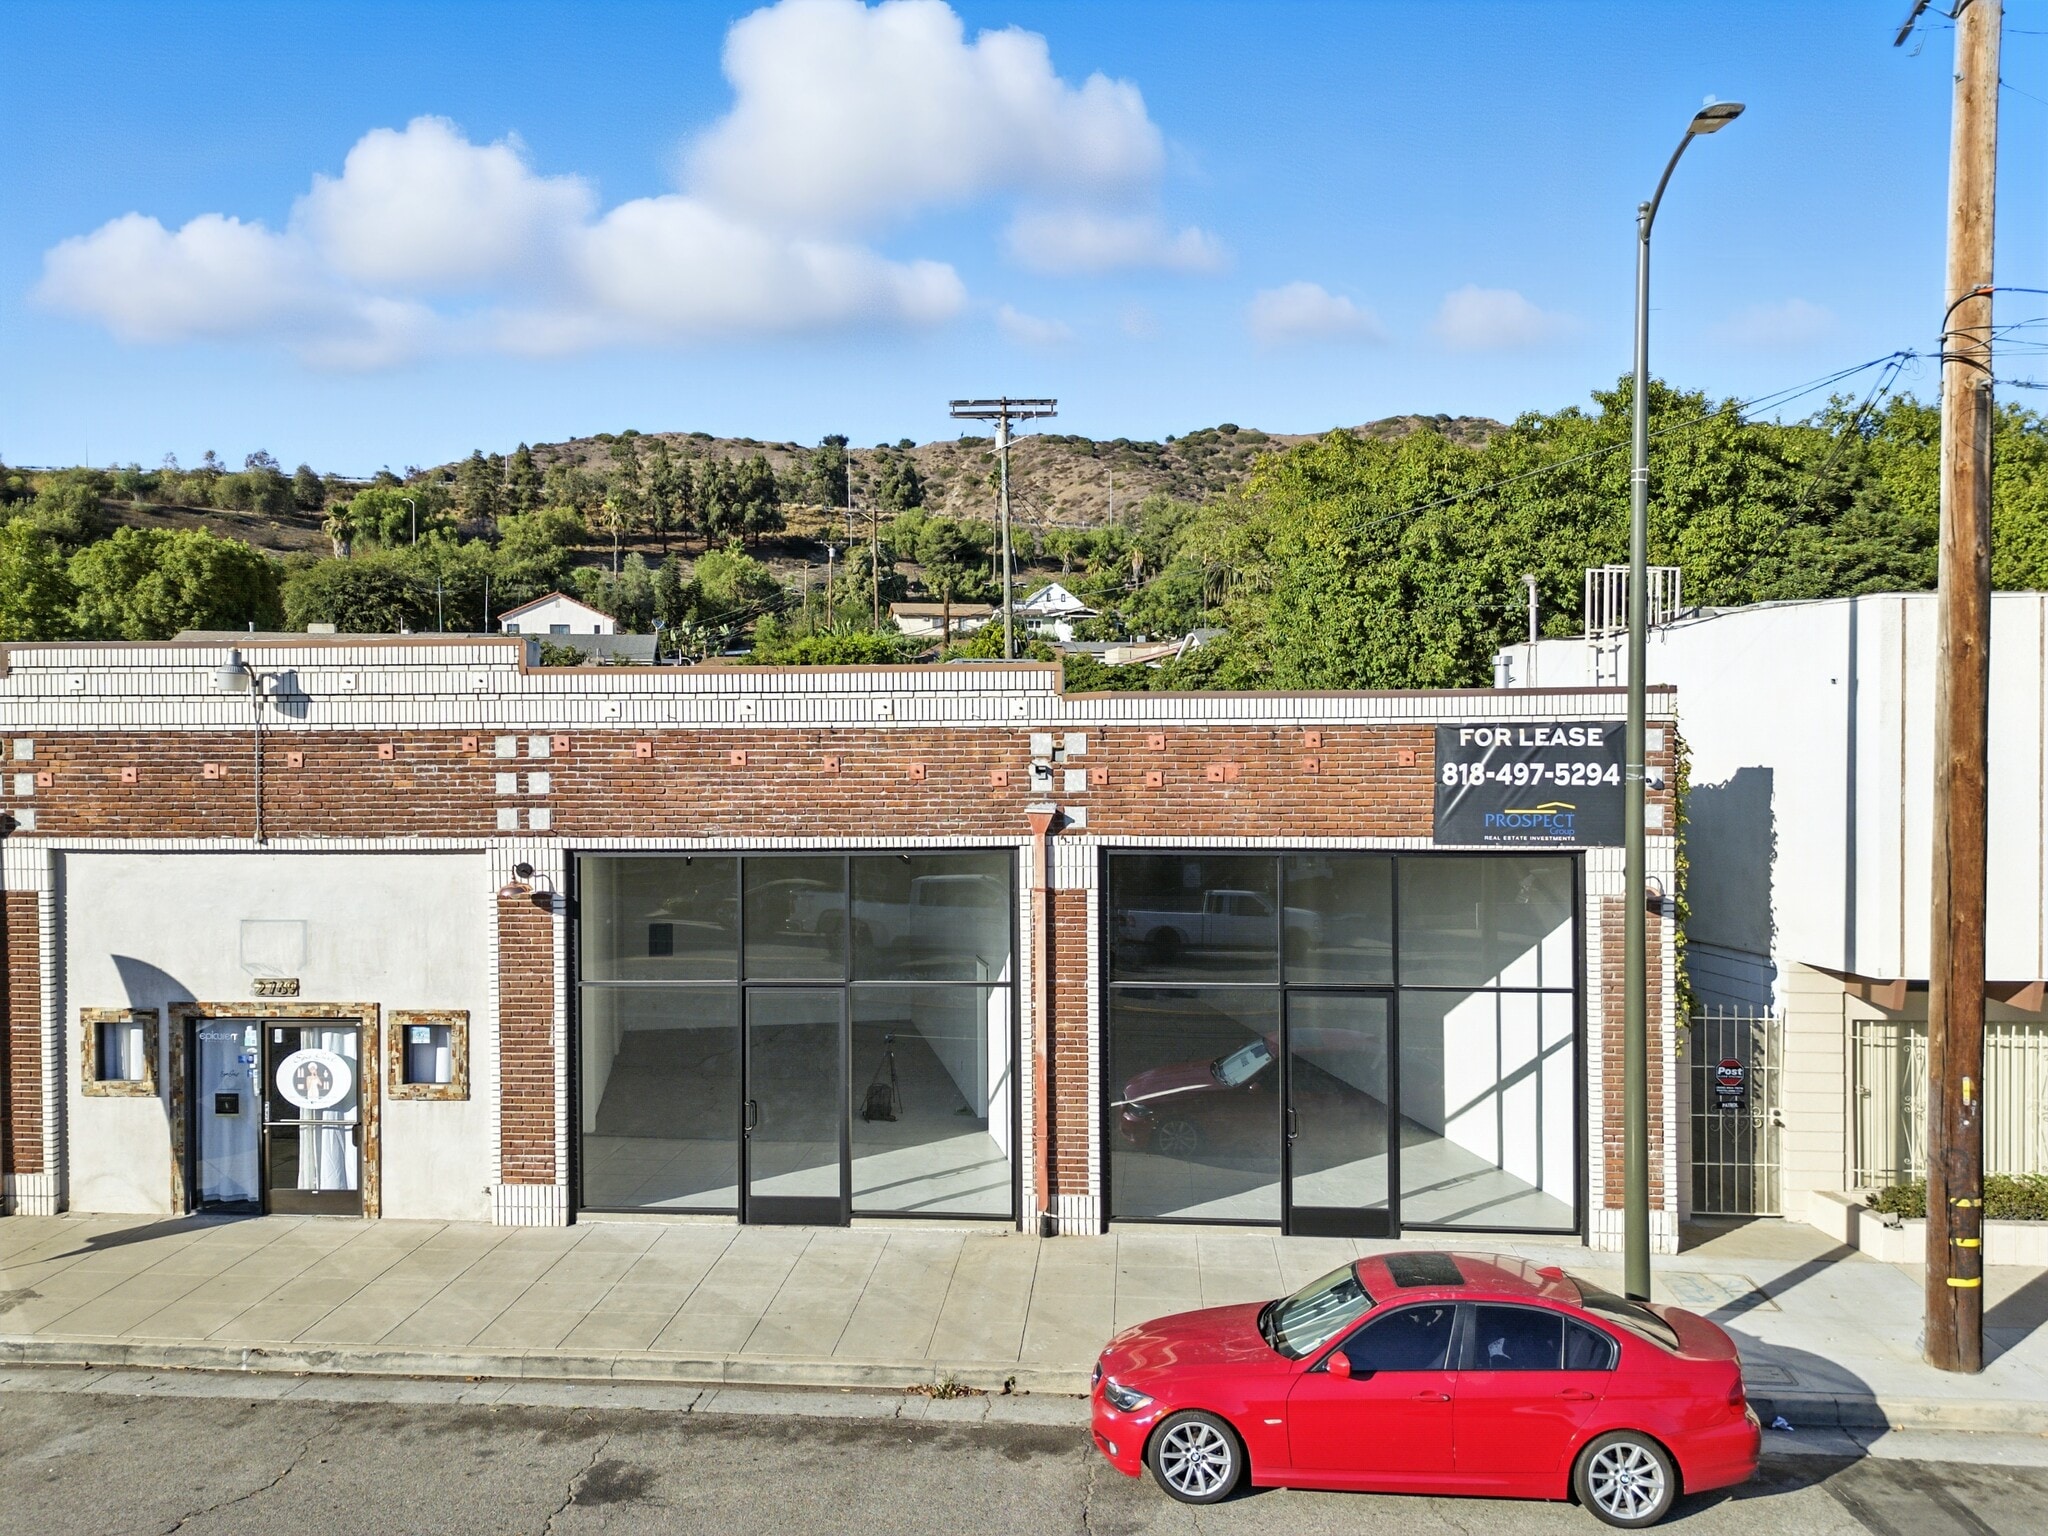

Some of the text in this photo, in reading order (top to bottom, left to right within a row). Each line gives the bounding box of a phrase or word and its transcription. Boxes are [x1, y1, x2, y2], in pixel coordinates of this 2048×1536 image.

[1460, 728, 1604, 747] FOR LEASE
[1442, 762, 1621, 786] 818-497-5294
[1484, 813, 1575, 828] PROSPECT
[1549, 827, 1575, 836] Group
[256, 980, 298, 995] 2769
[1717, 1066, 1743, 1075] Post
